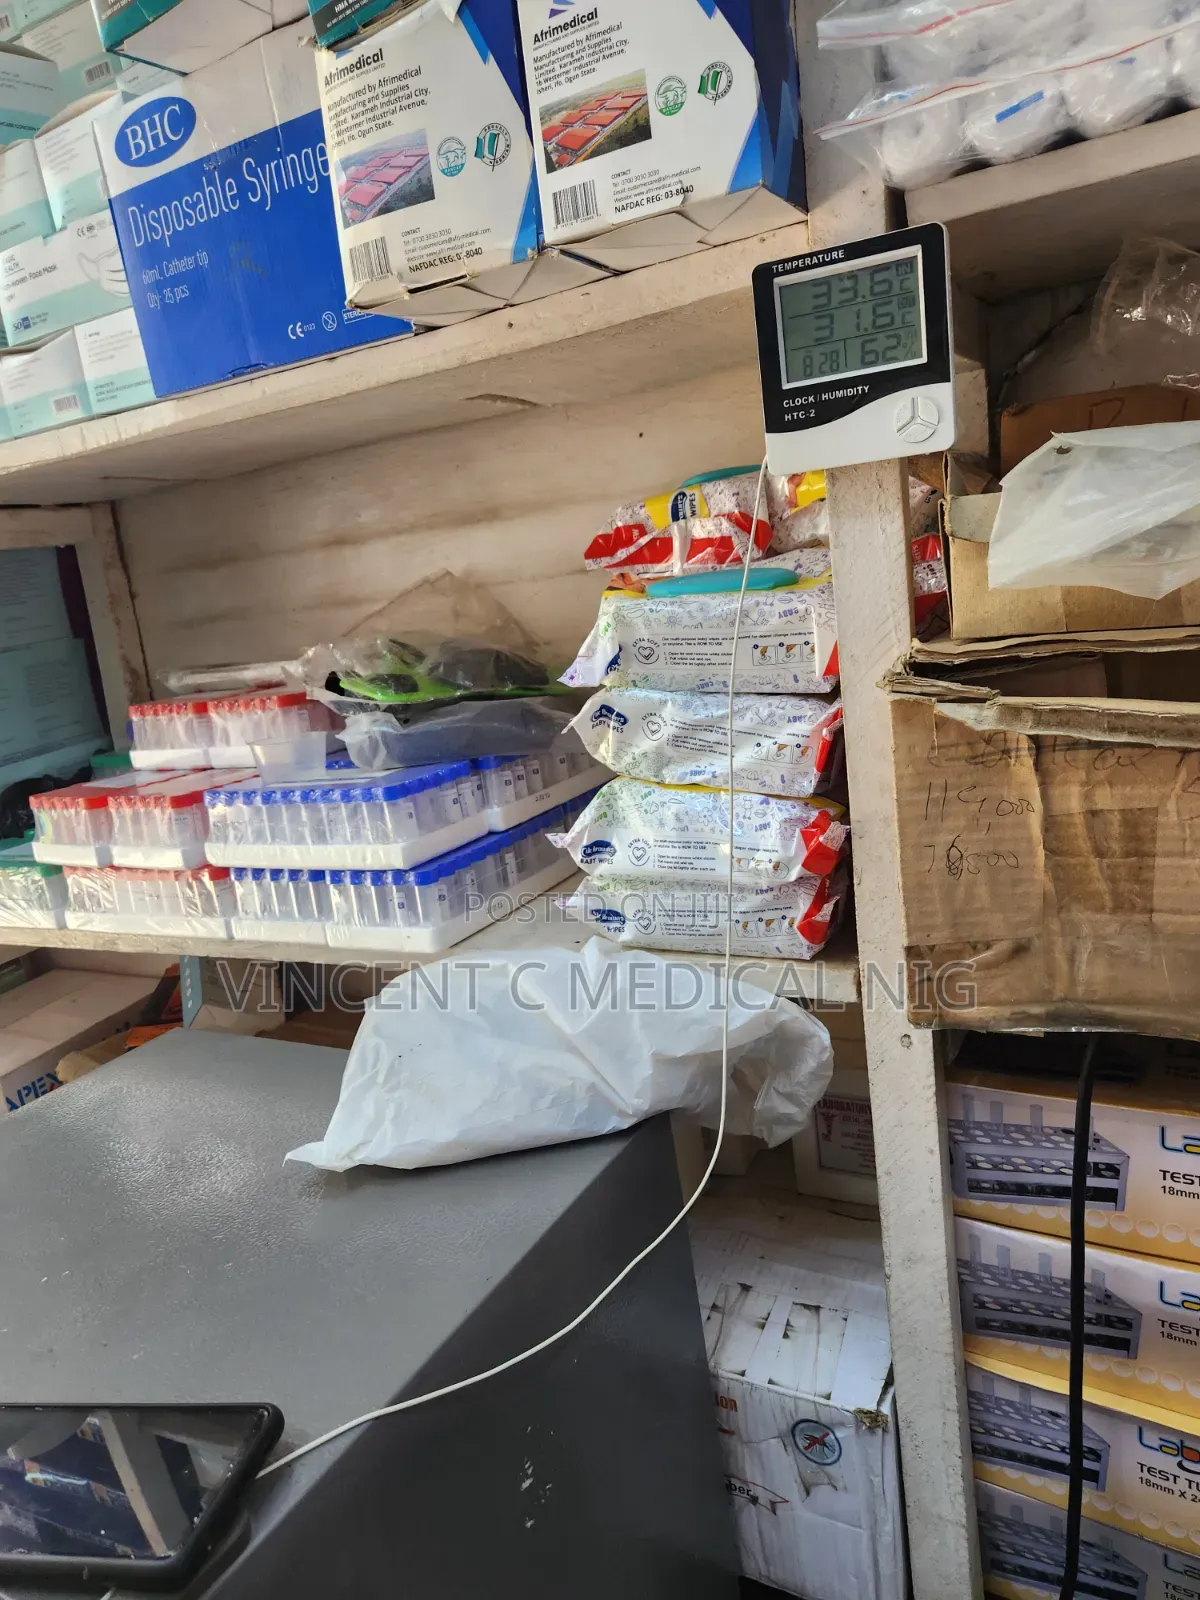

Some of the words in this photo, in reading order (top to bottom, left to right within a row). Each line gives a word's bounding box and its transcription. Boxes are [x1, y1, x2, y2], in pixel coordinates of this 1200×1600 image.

[533, 7, 598, 45] Afrimedical
[533, 42, 574, 64] Manufactured
[576, 38, 584, 47] by
[585, 22, 622, 42] Afrimedical
[534, 52, 574, 72] Manufacturing
[576, 46, 586, 56] and
[587, 36, 612, 51] Supplies
[560, 56, 584, 70] Karameh
[586, 43, 614, 58] Industrial
[572, 56, 600, 72] Industrial
[324, 48, 384, 88] Afrimedical
[368, 84, 377, 94] by
[378, 65, 422, 88] Afrimedical
[564, 74, 580, 84] Ogun
[368, 94, 380, 104] and
[380, 84, 410, 100] Supplies
[351, 104, 378, 120] Karameh
[380, 92, 412, 109] Industrial
[366, 108, 398, 124] Industrial
[124, 104, 184, 160] BHC
[358, 126, 374, 138] Ogun
[611, 169, 631, 180] CONTACT
[128, 171, 239, 247] Disposable
[243, 142, 330, 210] Syringe
[614, 199, 644, 214] NAFDAC
[646, 194, 663, 204] REG:
[664, 184, 694, 200] 03-8040
[402, 227, 420, 238] CONTACT
[164, 256, 196, 278] Catheter
[196, 249, 209, 267] tip
[408, 259, 438, 273] NAFDAC
[440, 254, 456, 266] REG:
[772, 249, 845, 274] TEMPERATURE
[29, 270, 42, 280] Face
[42, 264, 58, 275] Mask
[164, 288, 174, 304] 25
[175, 284, 190, 303] pcs
[811, 266, 893, 311] 33.6
[784, 394, 816, 408] CLOCK
[817, 394, 820, 402] /
[822, 385, 870, 400] HUMIDITY
[784, 410, 816, 422] HTC-2
[689, 492, 697, 518] WIPES
[632, 638, 646, 648] EXTRA
[641, 712, 656, 720] EXTRA
[607, 723, 624, 734] WPES
[628, 838, 640, 848] EXTRA
[1160, 1185, 1200, 1200] 18mm
[1158, 1318, 1200, 1337] TEST
[1160, 1331, 1197, 1346] 18mm
[1136, 1461, 1180, 1484] TEST
[726, 1480, 752, 1496] ber
[1139, 1476, 1174, 1495] 18mm
[1178, 1489, 1187, 1500] X
[1190, 1494, 1200, 1503] 2
